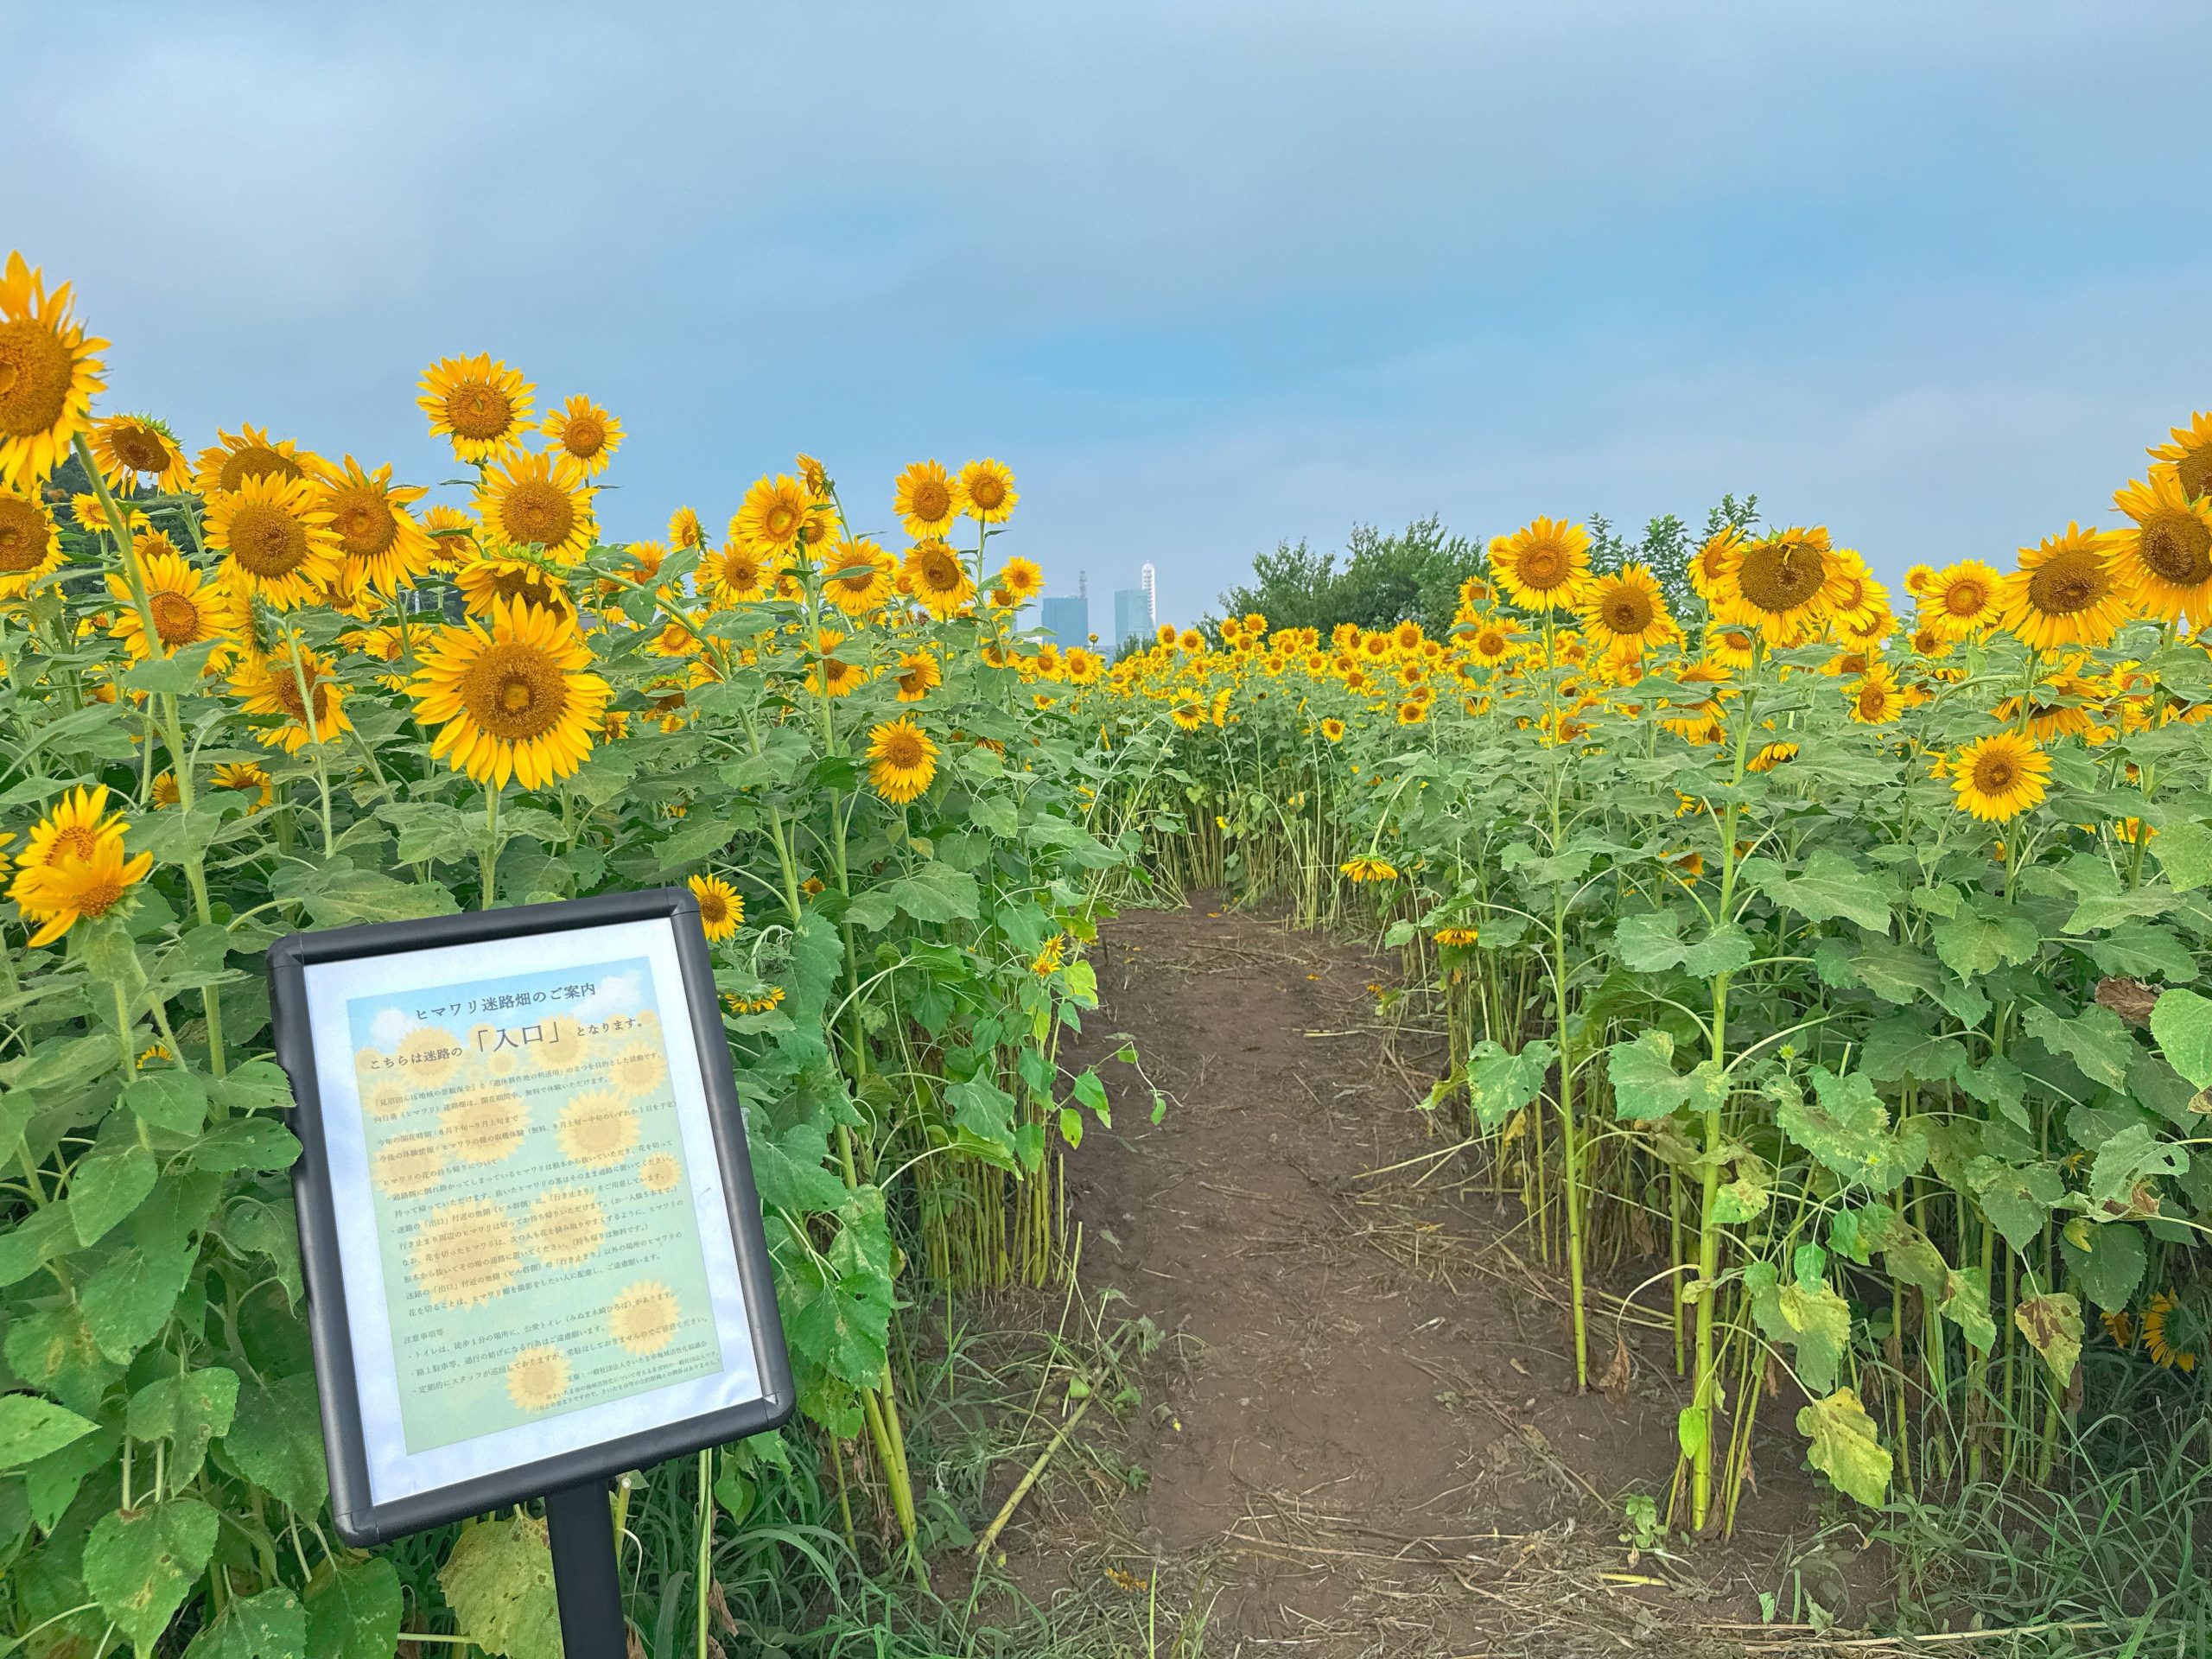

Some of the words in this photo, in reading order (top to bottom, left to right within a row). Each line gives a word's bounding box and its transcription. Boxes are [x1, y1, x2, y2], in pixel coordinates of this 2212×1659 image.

[415, 982, 596, 1022] ヒマワリ迷路畑のご案内
[369, 1045, 464, 1071] こちらは迷路の
[476, 1018, 560, 1055] 「入口」
[575, 1016, 643, 1037] となります。
[403, 1326, 444, 1344] 注意事項等
